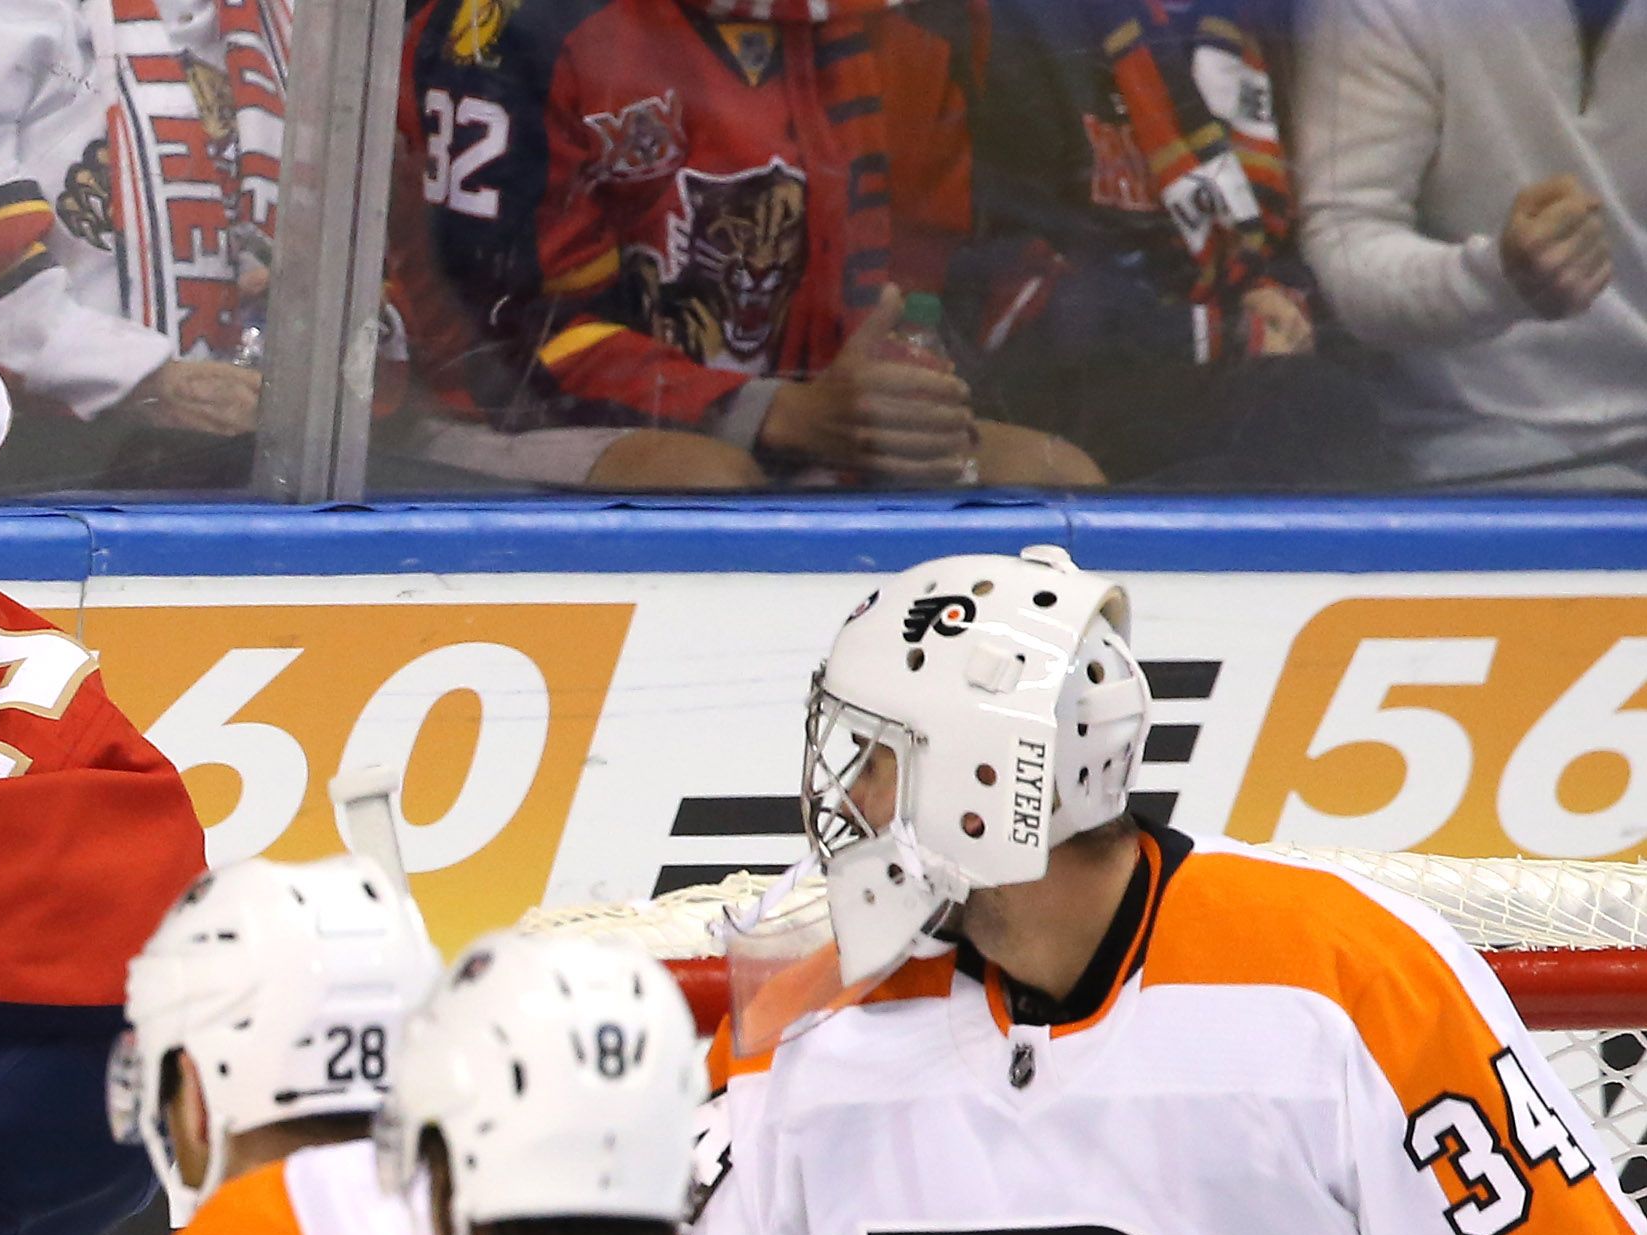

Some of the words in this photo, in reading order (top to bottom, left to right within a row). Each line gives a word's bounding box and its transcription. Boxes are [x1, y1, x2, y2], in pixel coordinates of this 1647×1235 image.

[423, 89, 509, 219] 32
[1012, 738, 1046, 848] FLYERS
[326, 1025, 386, 1081] 28
[595, 1023, 625, 1079] 8
